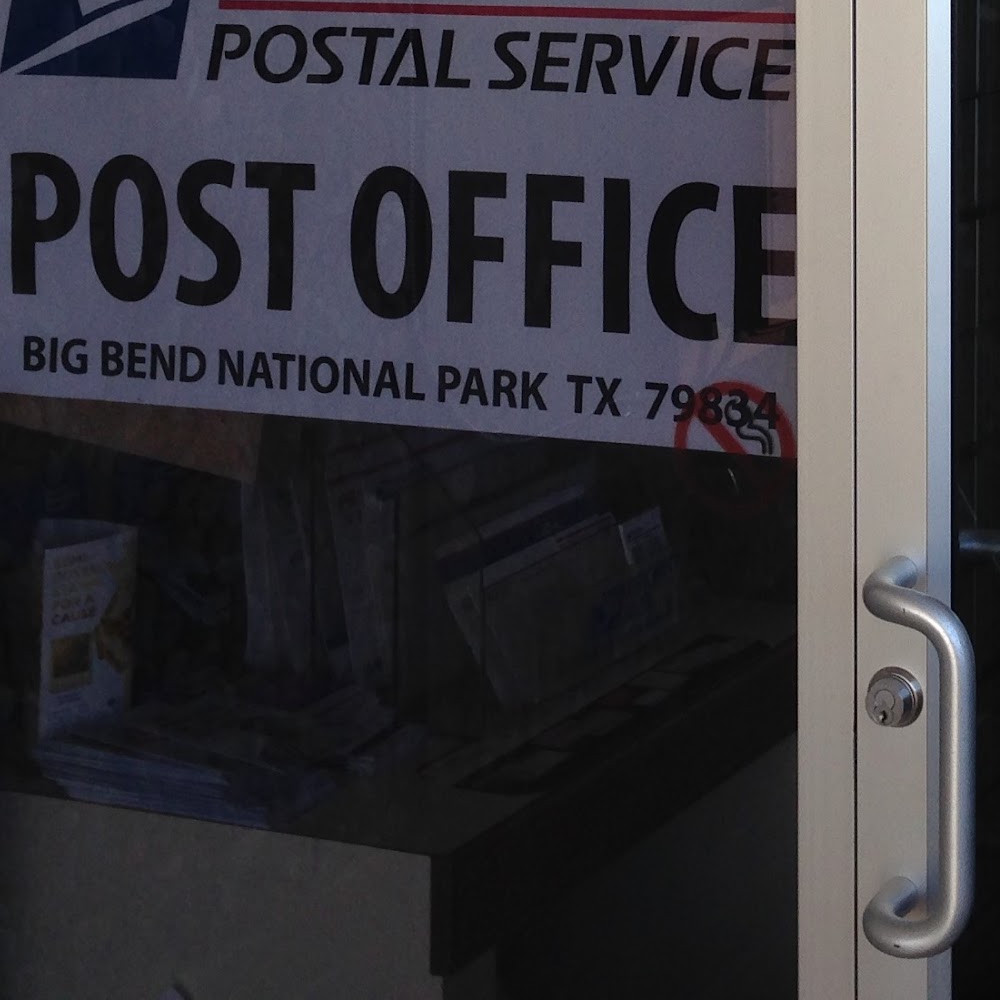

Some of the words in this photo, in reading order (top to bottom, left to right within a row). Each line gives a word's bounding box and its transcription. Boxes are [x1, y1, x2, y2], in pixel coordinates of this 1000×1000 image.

[206, 23, 472, 90] POSTAL
[488, 31, 793, 101] SERVICE
[10, 151, 315, 312] POST
[350, 165, 797, 345] OFFICE
[22, 335, 90, 375] BIG
[101, 340, 207, 383] BEND
[217, 348, 426, 402] NATIONAL
[436, 365, 549, 411] PARK
[567, 374, 623, 418] TX
[645, 381, 778, 430] 79834
